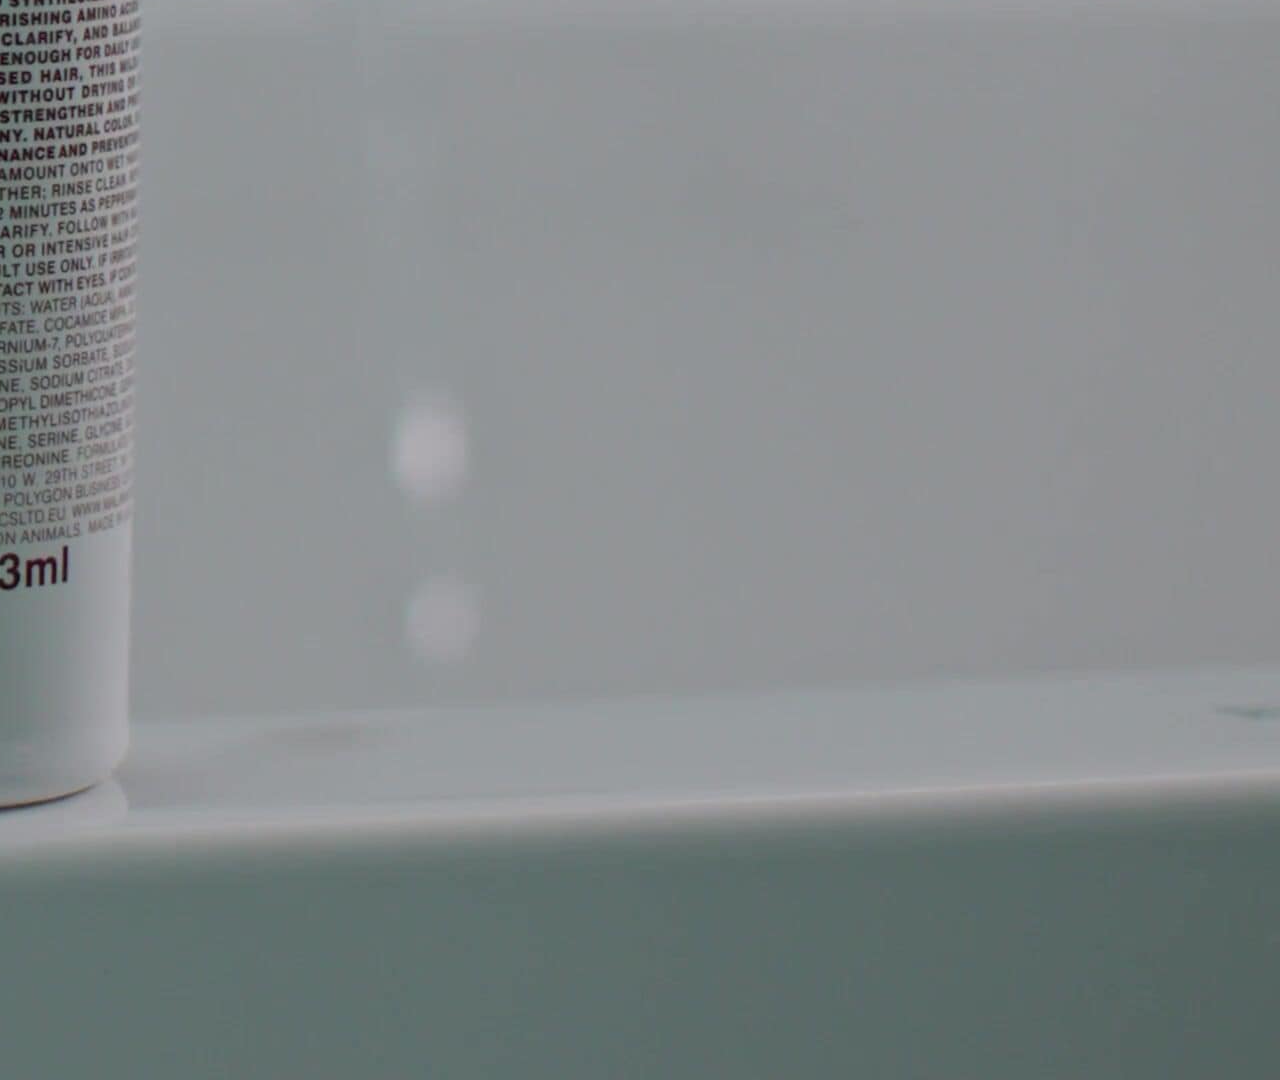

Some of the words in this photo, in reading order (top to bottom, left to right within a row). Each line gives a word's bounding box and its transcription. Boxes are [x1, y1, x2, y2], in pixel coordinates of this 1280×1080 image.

[76, 4, 116, 22] AMINO
[0, 28, 77, 48] CLARIFY,
[82, 25, 108, 41] AND
[75, 44, 101, 61] FOR
[39, 66, 83, 85] HAIR,
[33, 121, 100, 142] NATURAL
[57, 142, 88, 159] AND
[69, 159, 103, 177] ONTO
